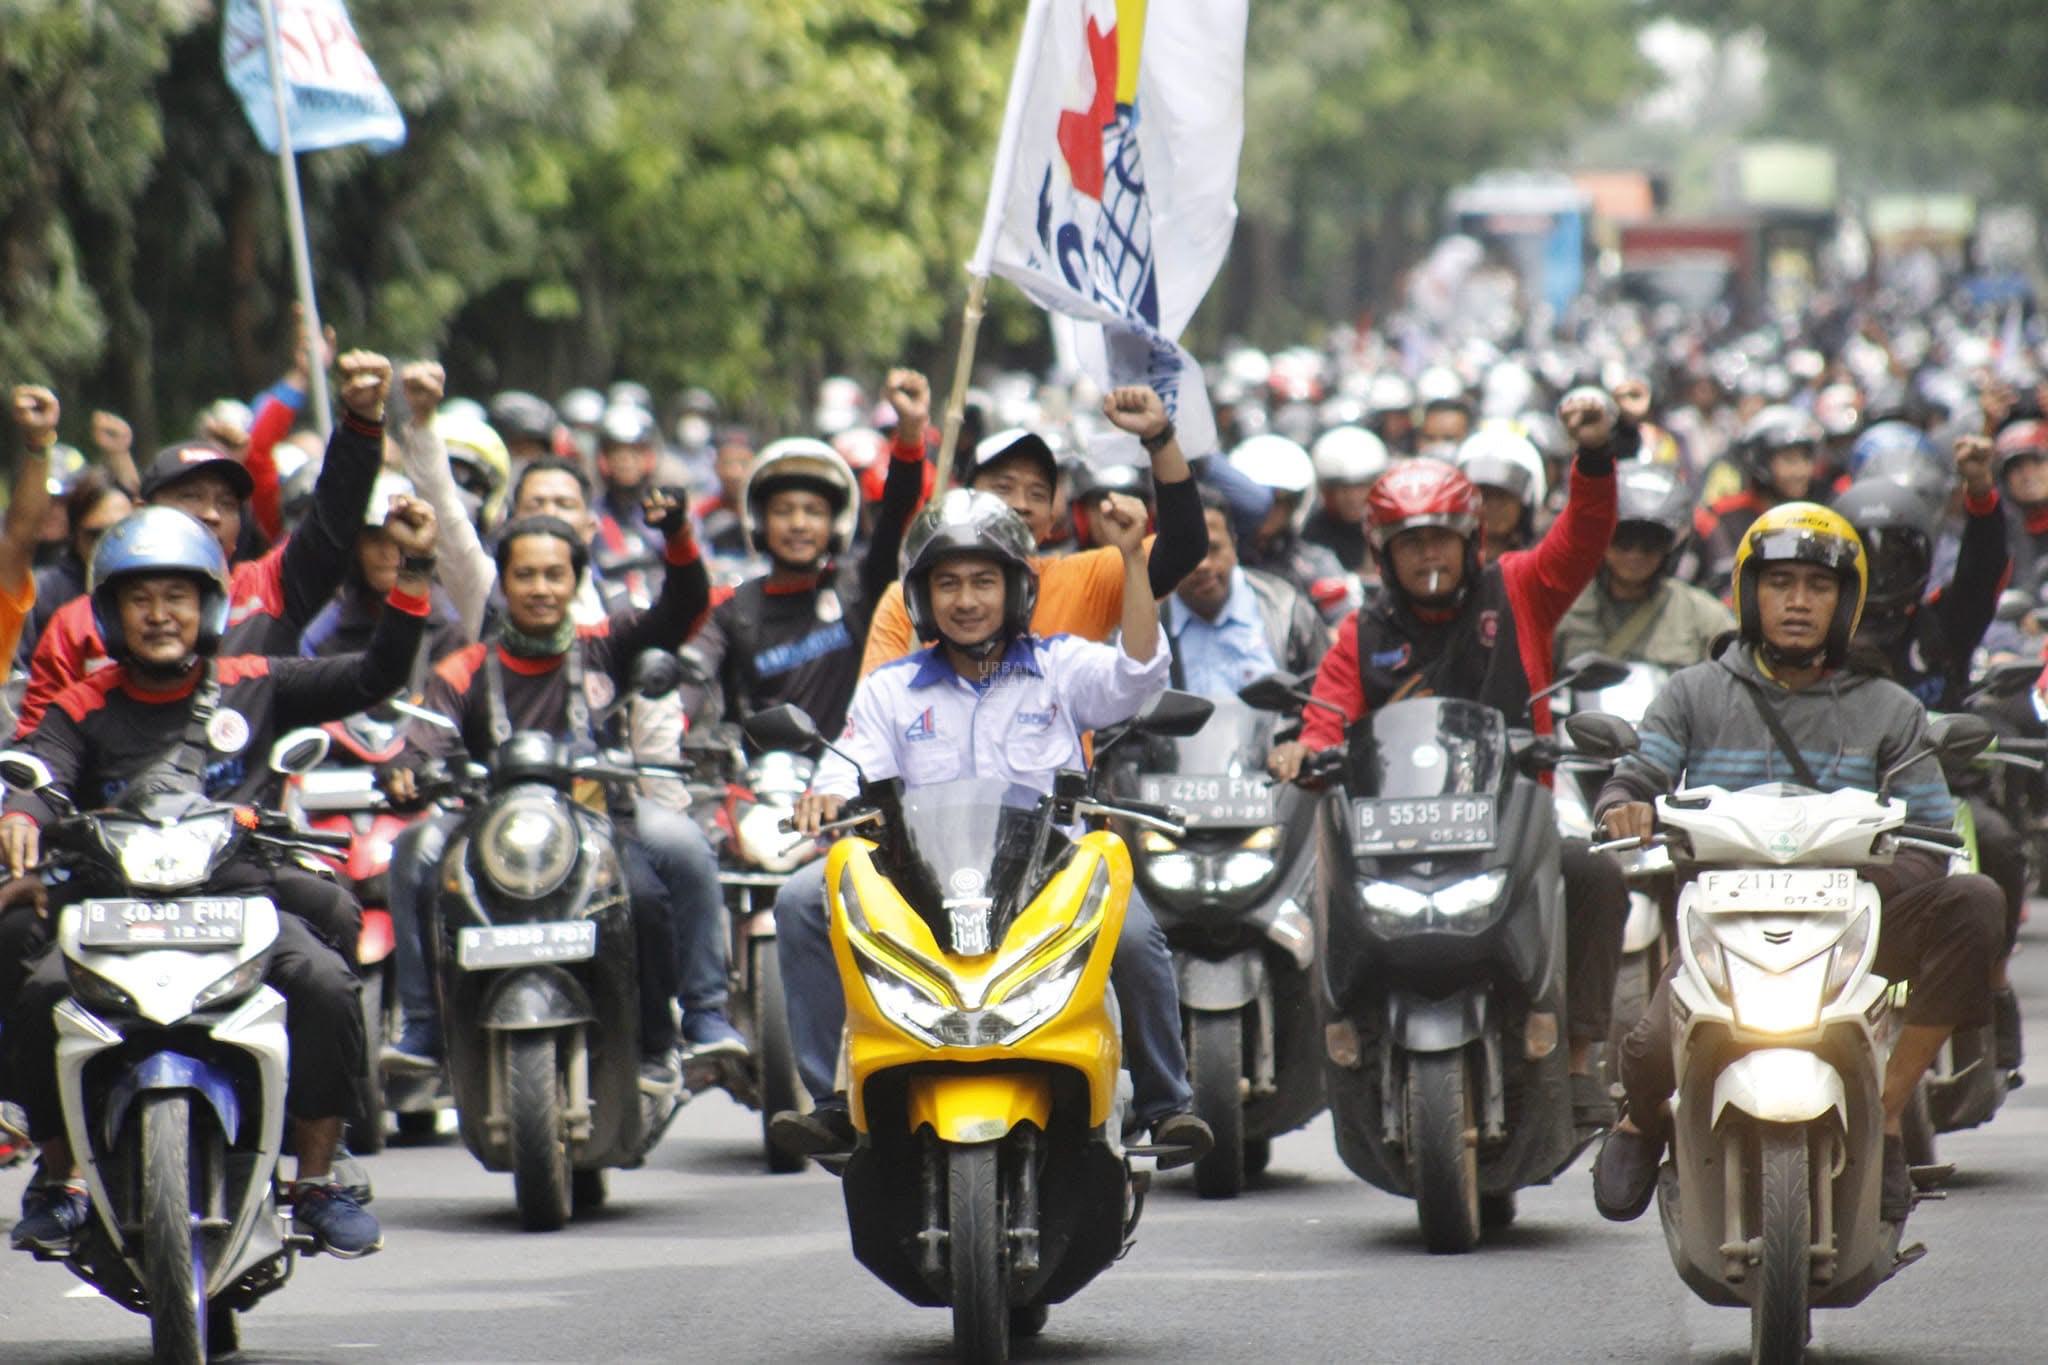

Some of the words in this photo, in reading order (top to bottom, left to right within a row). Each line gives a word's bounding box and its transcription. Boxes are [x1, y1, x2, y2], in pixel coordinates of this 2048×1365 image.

[1171, 780, 1219, 801] 4260
[1361, 807, 1375, 827] B
[1389, 803, 1441, 826] 5535
[1451, 801, 1489, 822] FDP
[1708, 874, 1720, 892] F
[1737, 873, 1794, 889] 2117
[1823, 872, 1849, 889] JB
[91, 903, 105, 923] B
[121, 902, 180, 923] 4030
